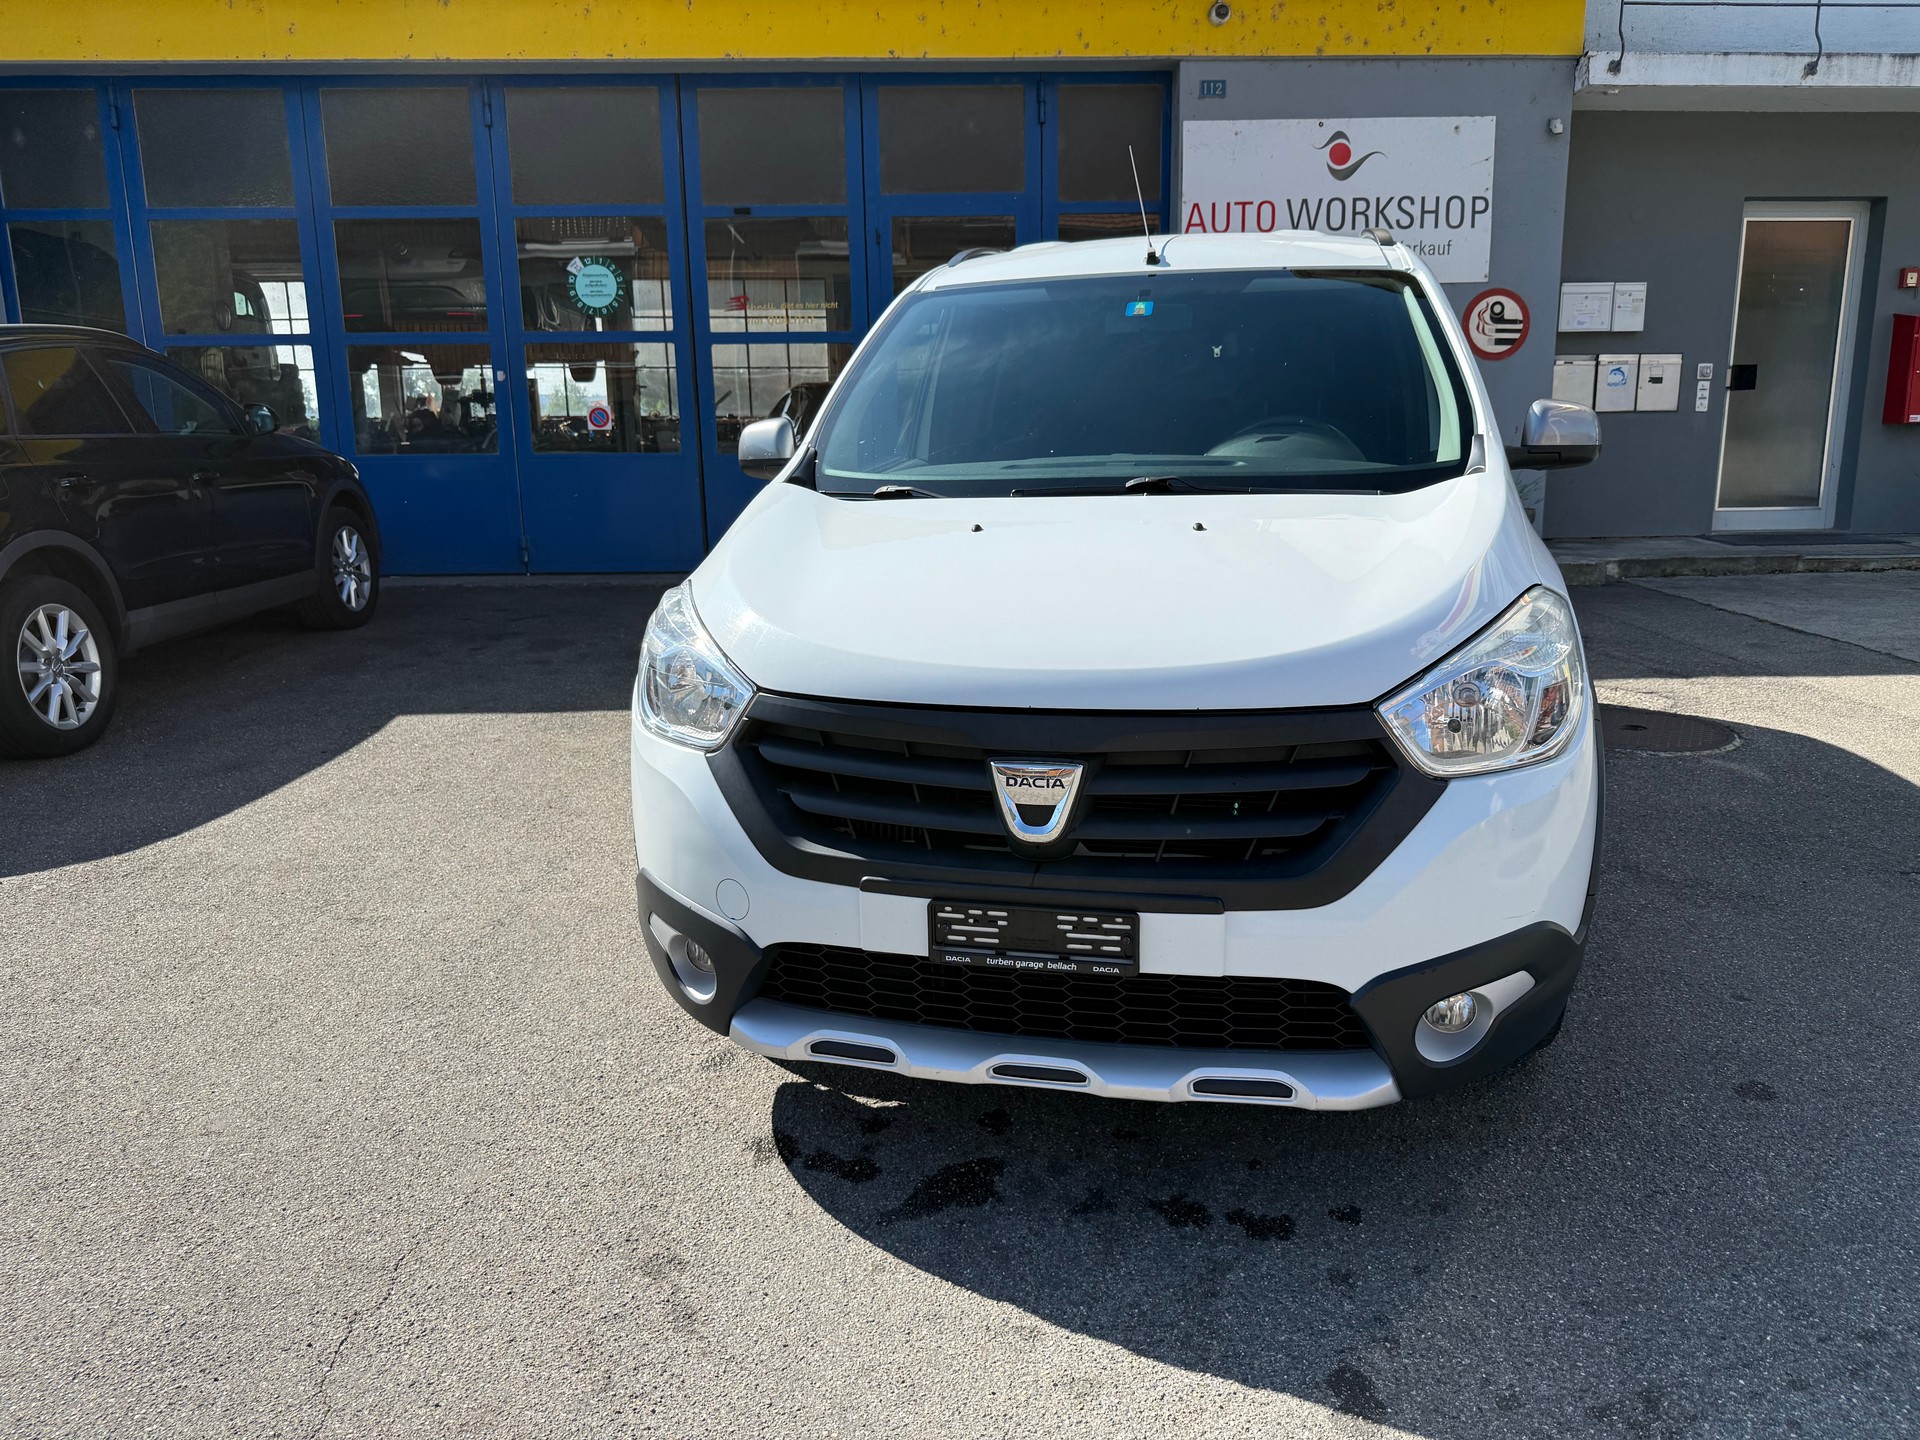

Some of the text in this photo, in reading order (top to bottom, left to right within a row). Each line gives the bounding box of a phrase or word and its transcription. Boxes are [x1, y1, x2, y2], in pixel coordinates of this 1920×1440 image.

[1203, 82, 1222, 95] 112
[1184, 195, 1490, 234] AUTO WORKSHOP
[1401, 240, 1453, 256] rkauf
[805, 301, 819, 309] hier
[820, 301, 839, 309] nicht
[1005, 776, 1066, 789] DACIA
[945, 955, 1120, 974] DACIA turben garage bellach DACIA
